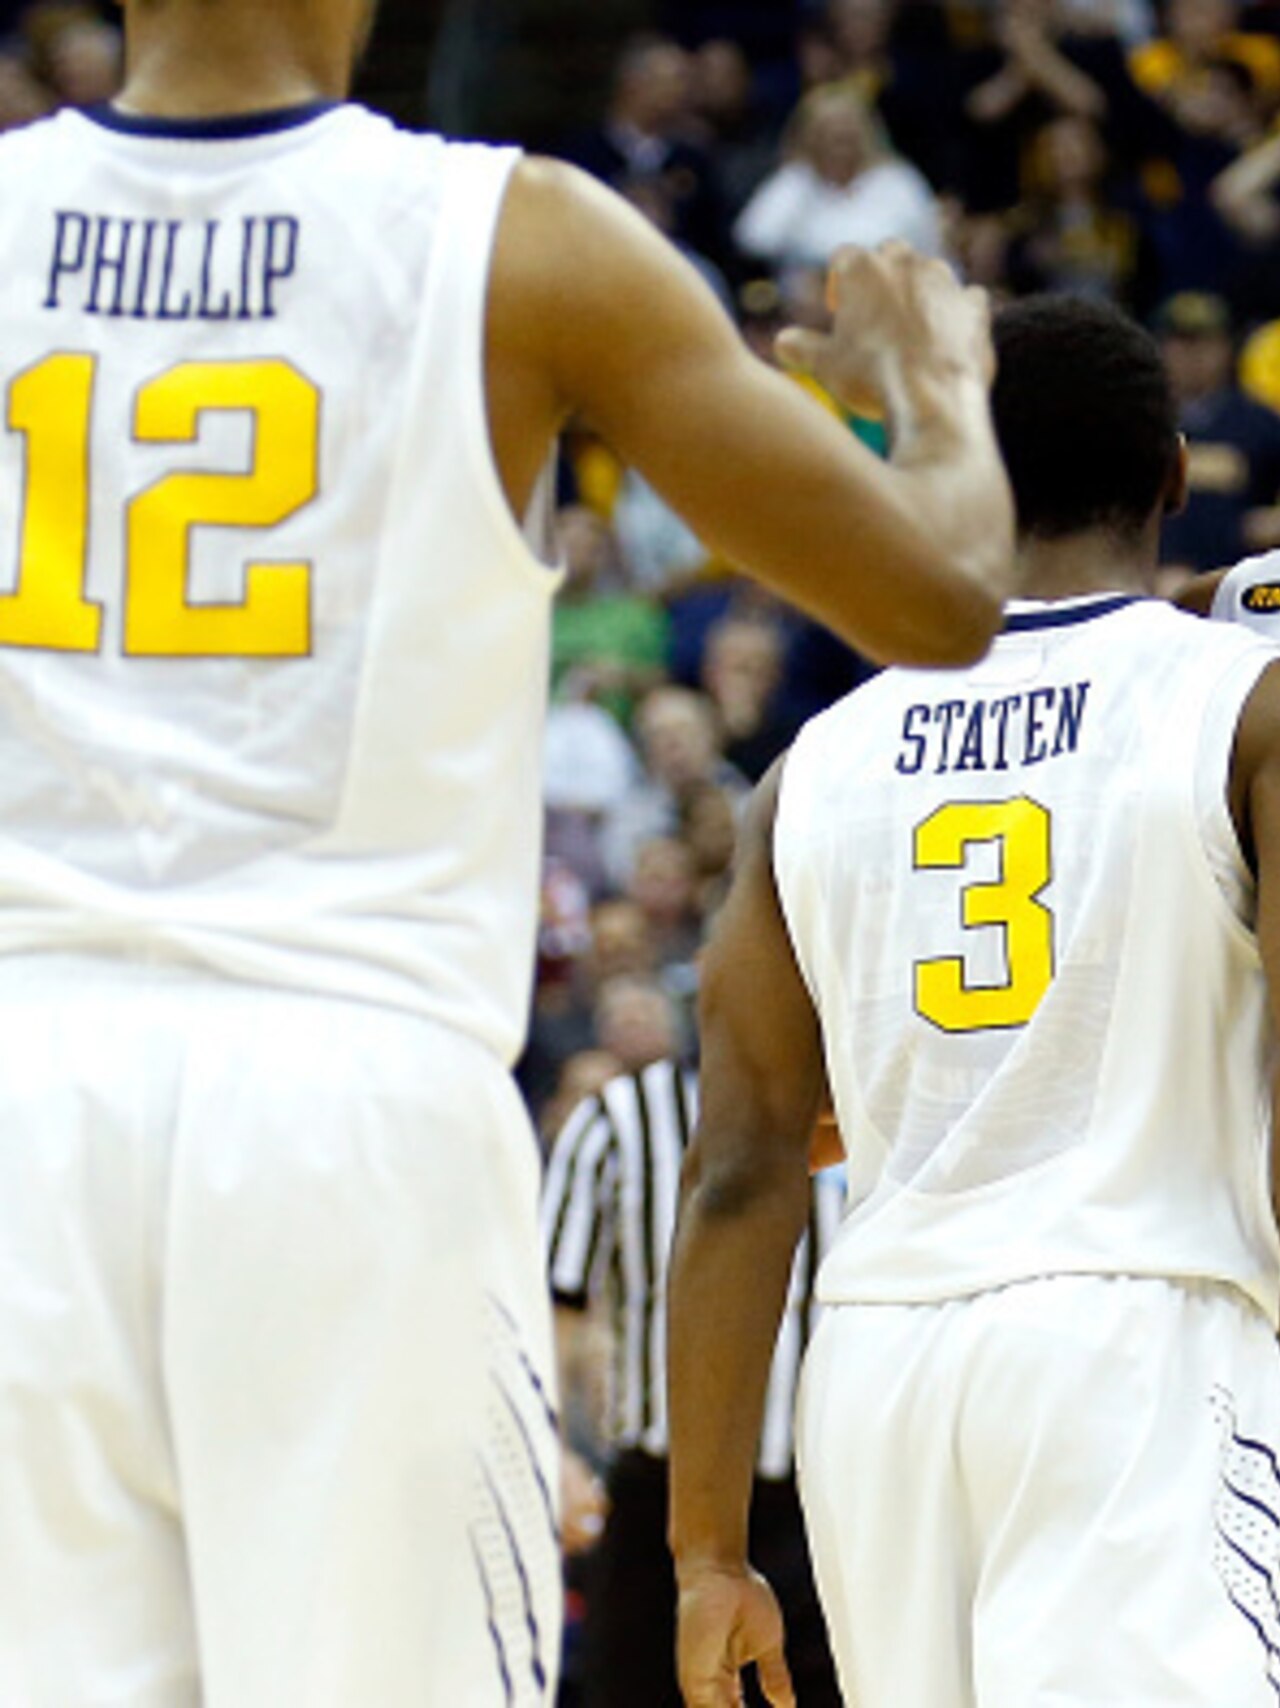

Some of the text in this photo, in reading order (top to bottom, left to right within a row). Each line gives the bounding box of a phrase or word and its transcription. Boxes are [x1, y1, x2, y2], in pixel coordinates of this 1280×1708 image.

[42, 210, 300, 320] PHILLIP
[0, 350, 322, 657] 12
[895, 681, 1090, 774] STATEN
[912, 793, 1055, 1034] 3
